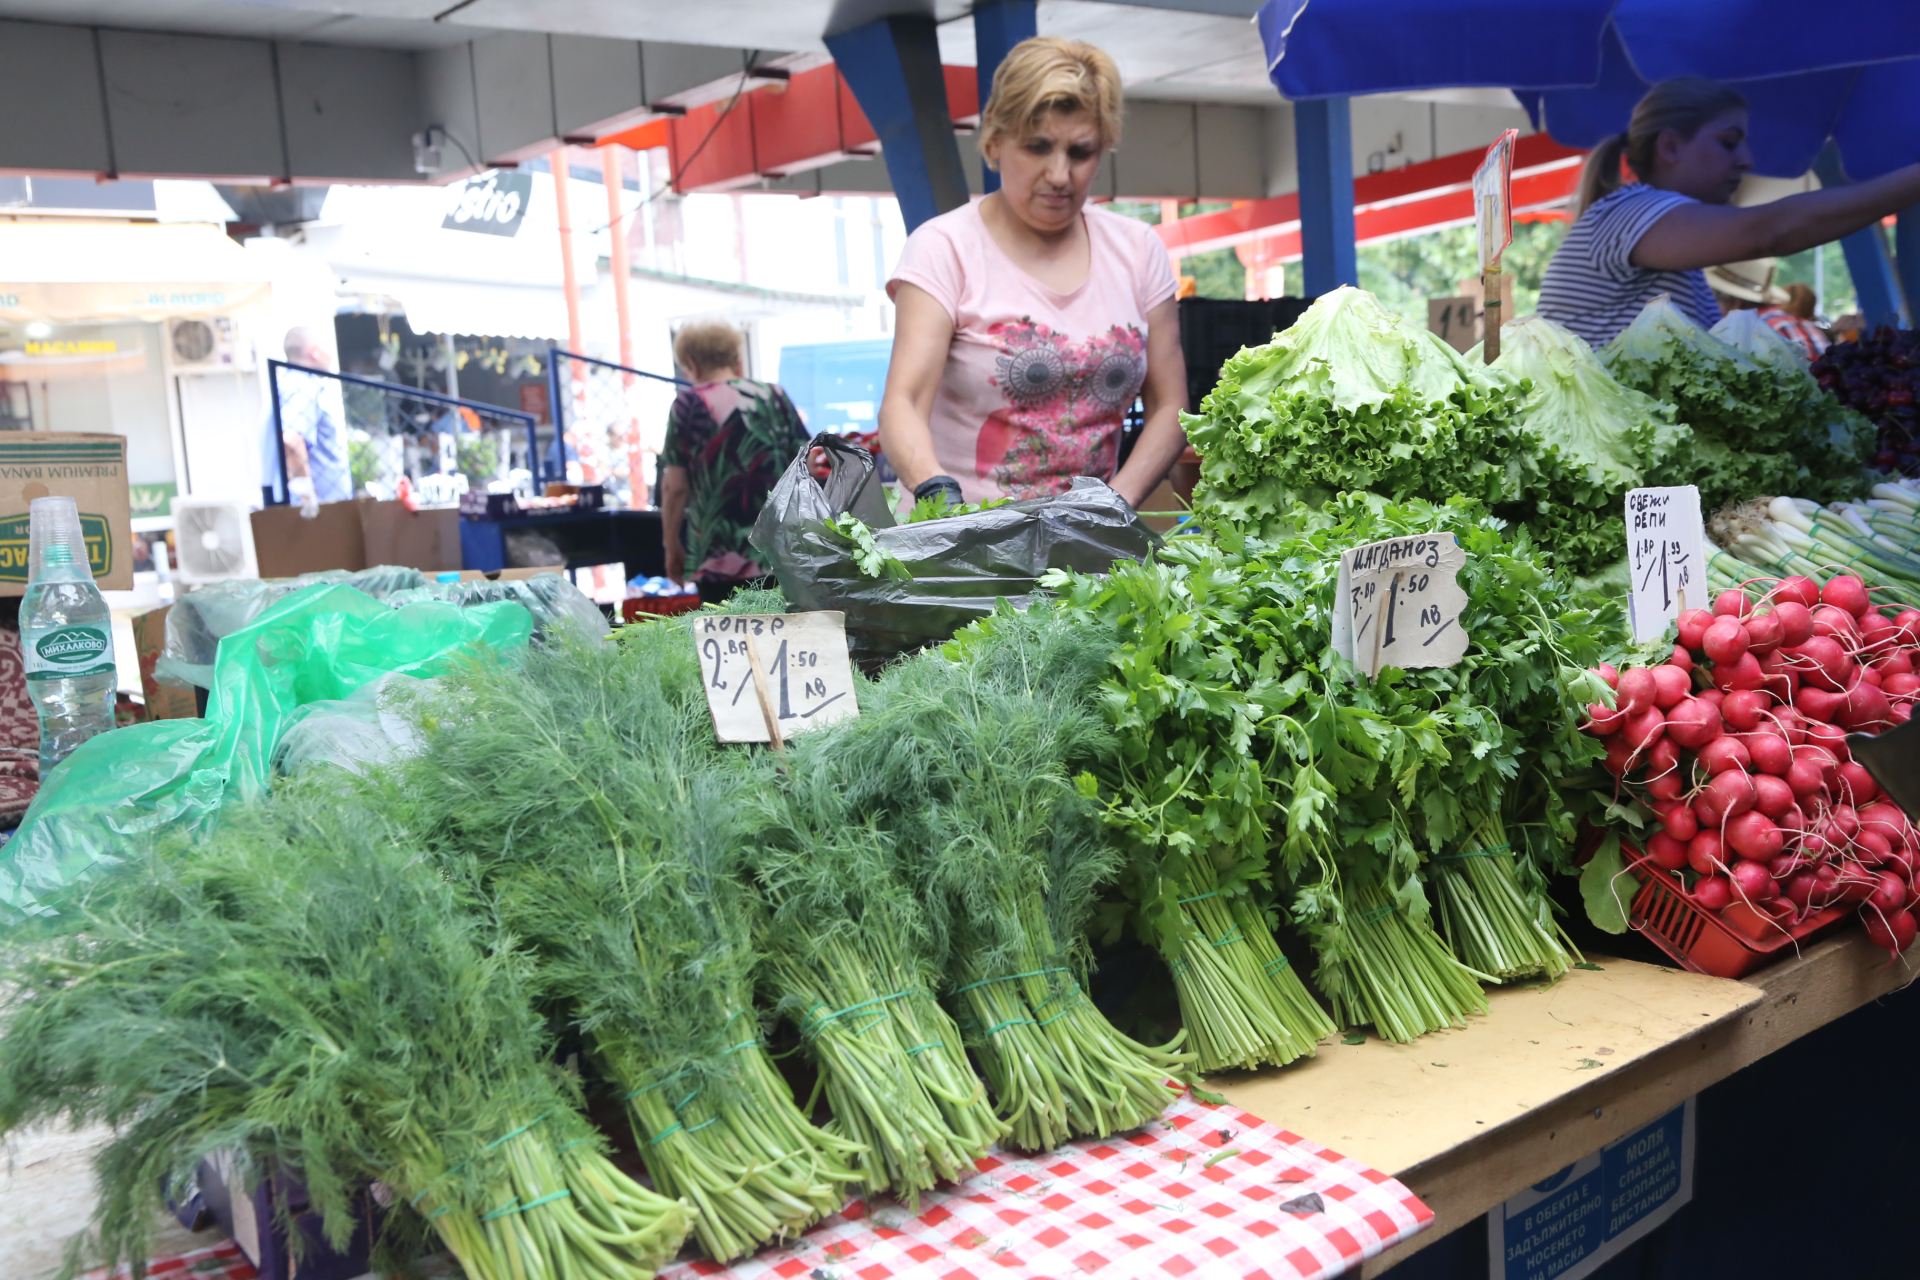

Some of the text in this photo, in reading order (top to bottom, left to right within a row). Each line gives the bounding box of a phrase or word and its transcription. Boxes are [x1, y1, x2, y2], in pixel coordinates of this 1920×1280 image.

[0, 466, 118, 479] PREMIUM BANA
[1630, 494, 1670, 512] СВЕЖИ
[1634, 511, 1667, 533] РЕПИ
[1352, 540, 1440, 574] МАГДАНОЗ
[703, 617, 785, 636] КОПЪР
[44, 641, 103, 656] МИХАЛКОВО
[1626, 1127, 1664, 1164] МОЛЯ
[1619, 1144, 1670, 1188] СПАЗВАЙ
[1611, 1159, 1676, 1213] БЕЗОПАСНА
[1525, 1183, 1589, 1231] В ОБЕКТА Е
[1609, 1176, 1676, 1235] ДИСТАНЦИЯ
[1507, 1195, 1602, 1261] ЗАДЪЛЖИТЕЛНО
[1527, 1224, 1586, 1270] НОСЕНЕТО
[1548, 1245, 1584, 1277] МАСКА
